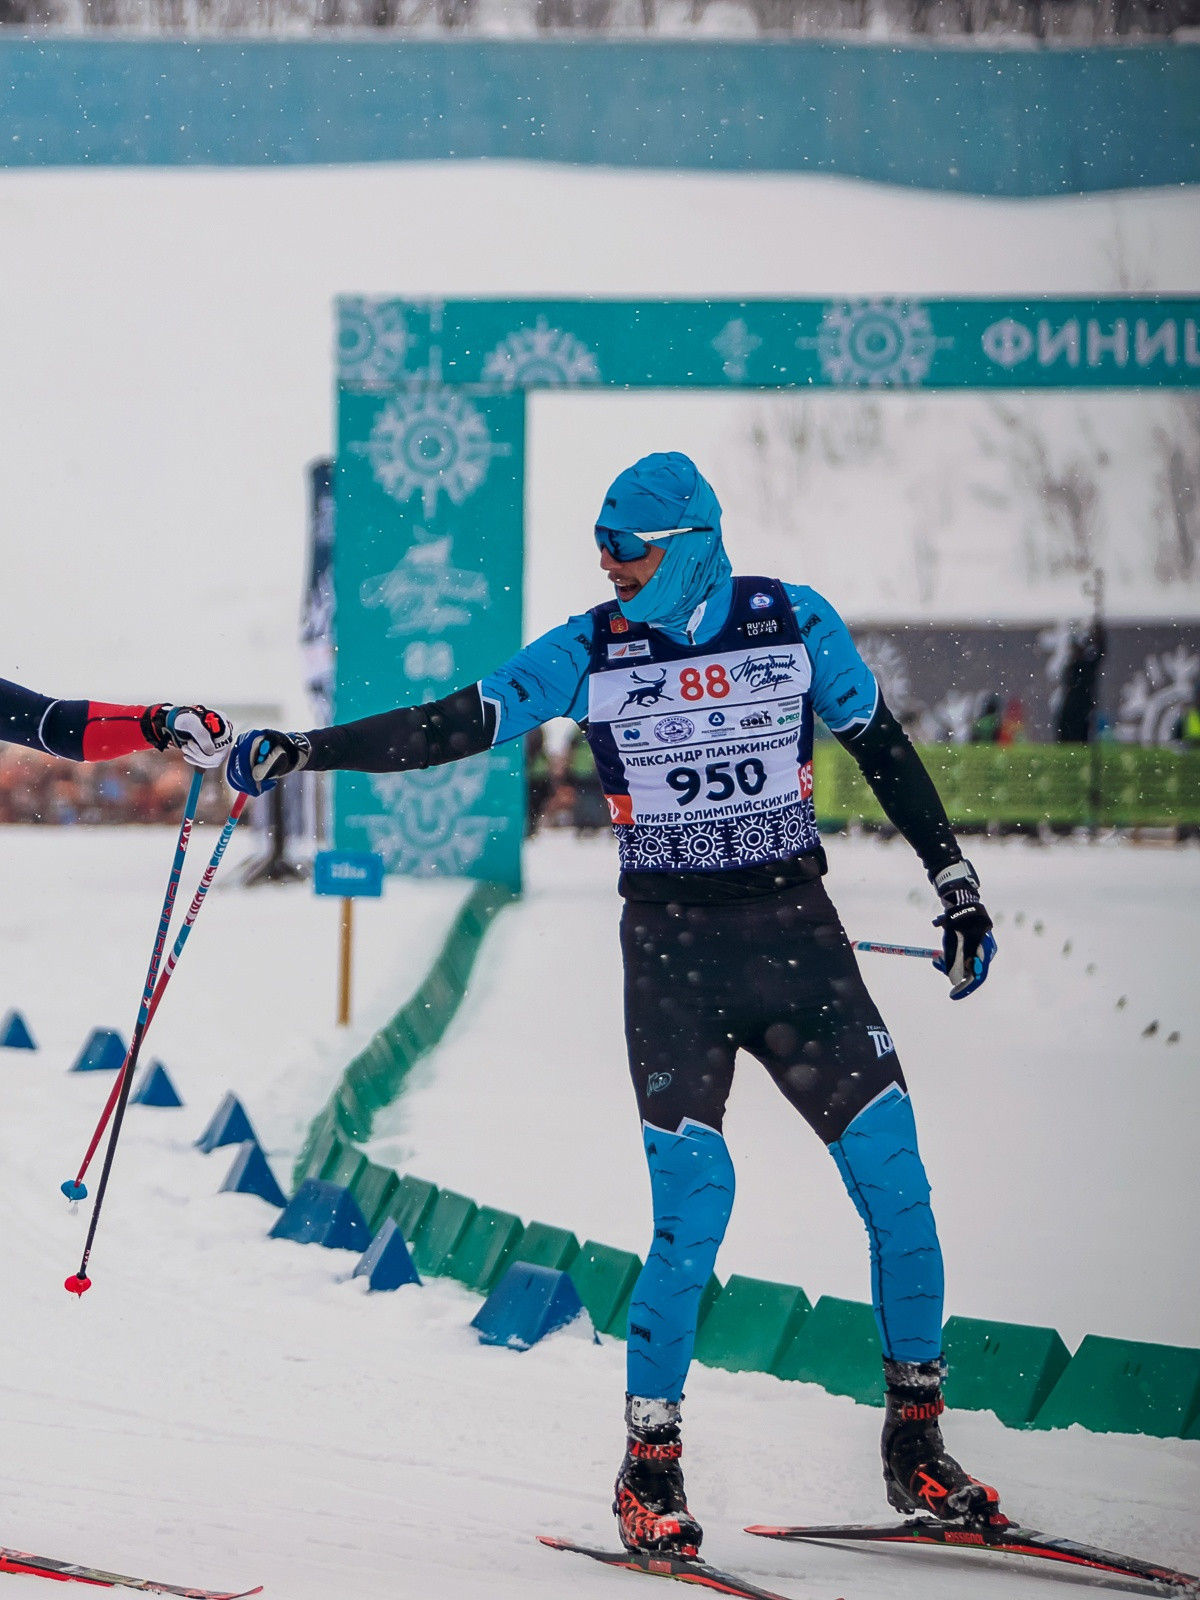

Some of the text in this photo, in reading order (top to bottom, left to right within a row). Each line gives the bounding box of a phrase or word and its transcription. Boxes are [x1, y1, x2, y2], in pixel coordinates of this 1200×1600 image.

[679, 664, 730, 701] 88
[730, 654, 800, 682] Праздник
[750, 673, 792, 691] Севера
[625, 749, 703, 767] АЛЕКСАНДР
[706, 730, 799, 759] ПАНЖИНСКИЙ
[665, 757, 768, 807] 950
[636, 789, 799, 824] ПРИЗЕР ОЛИМПИЙСКИХ ИГР
[944, 1531, 986, 1546] ROSSIGNOL
